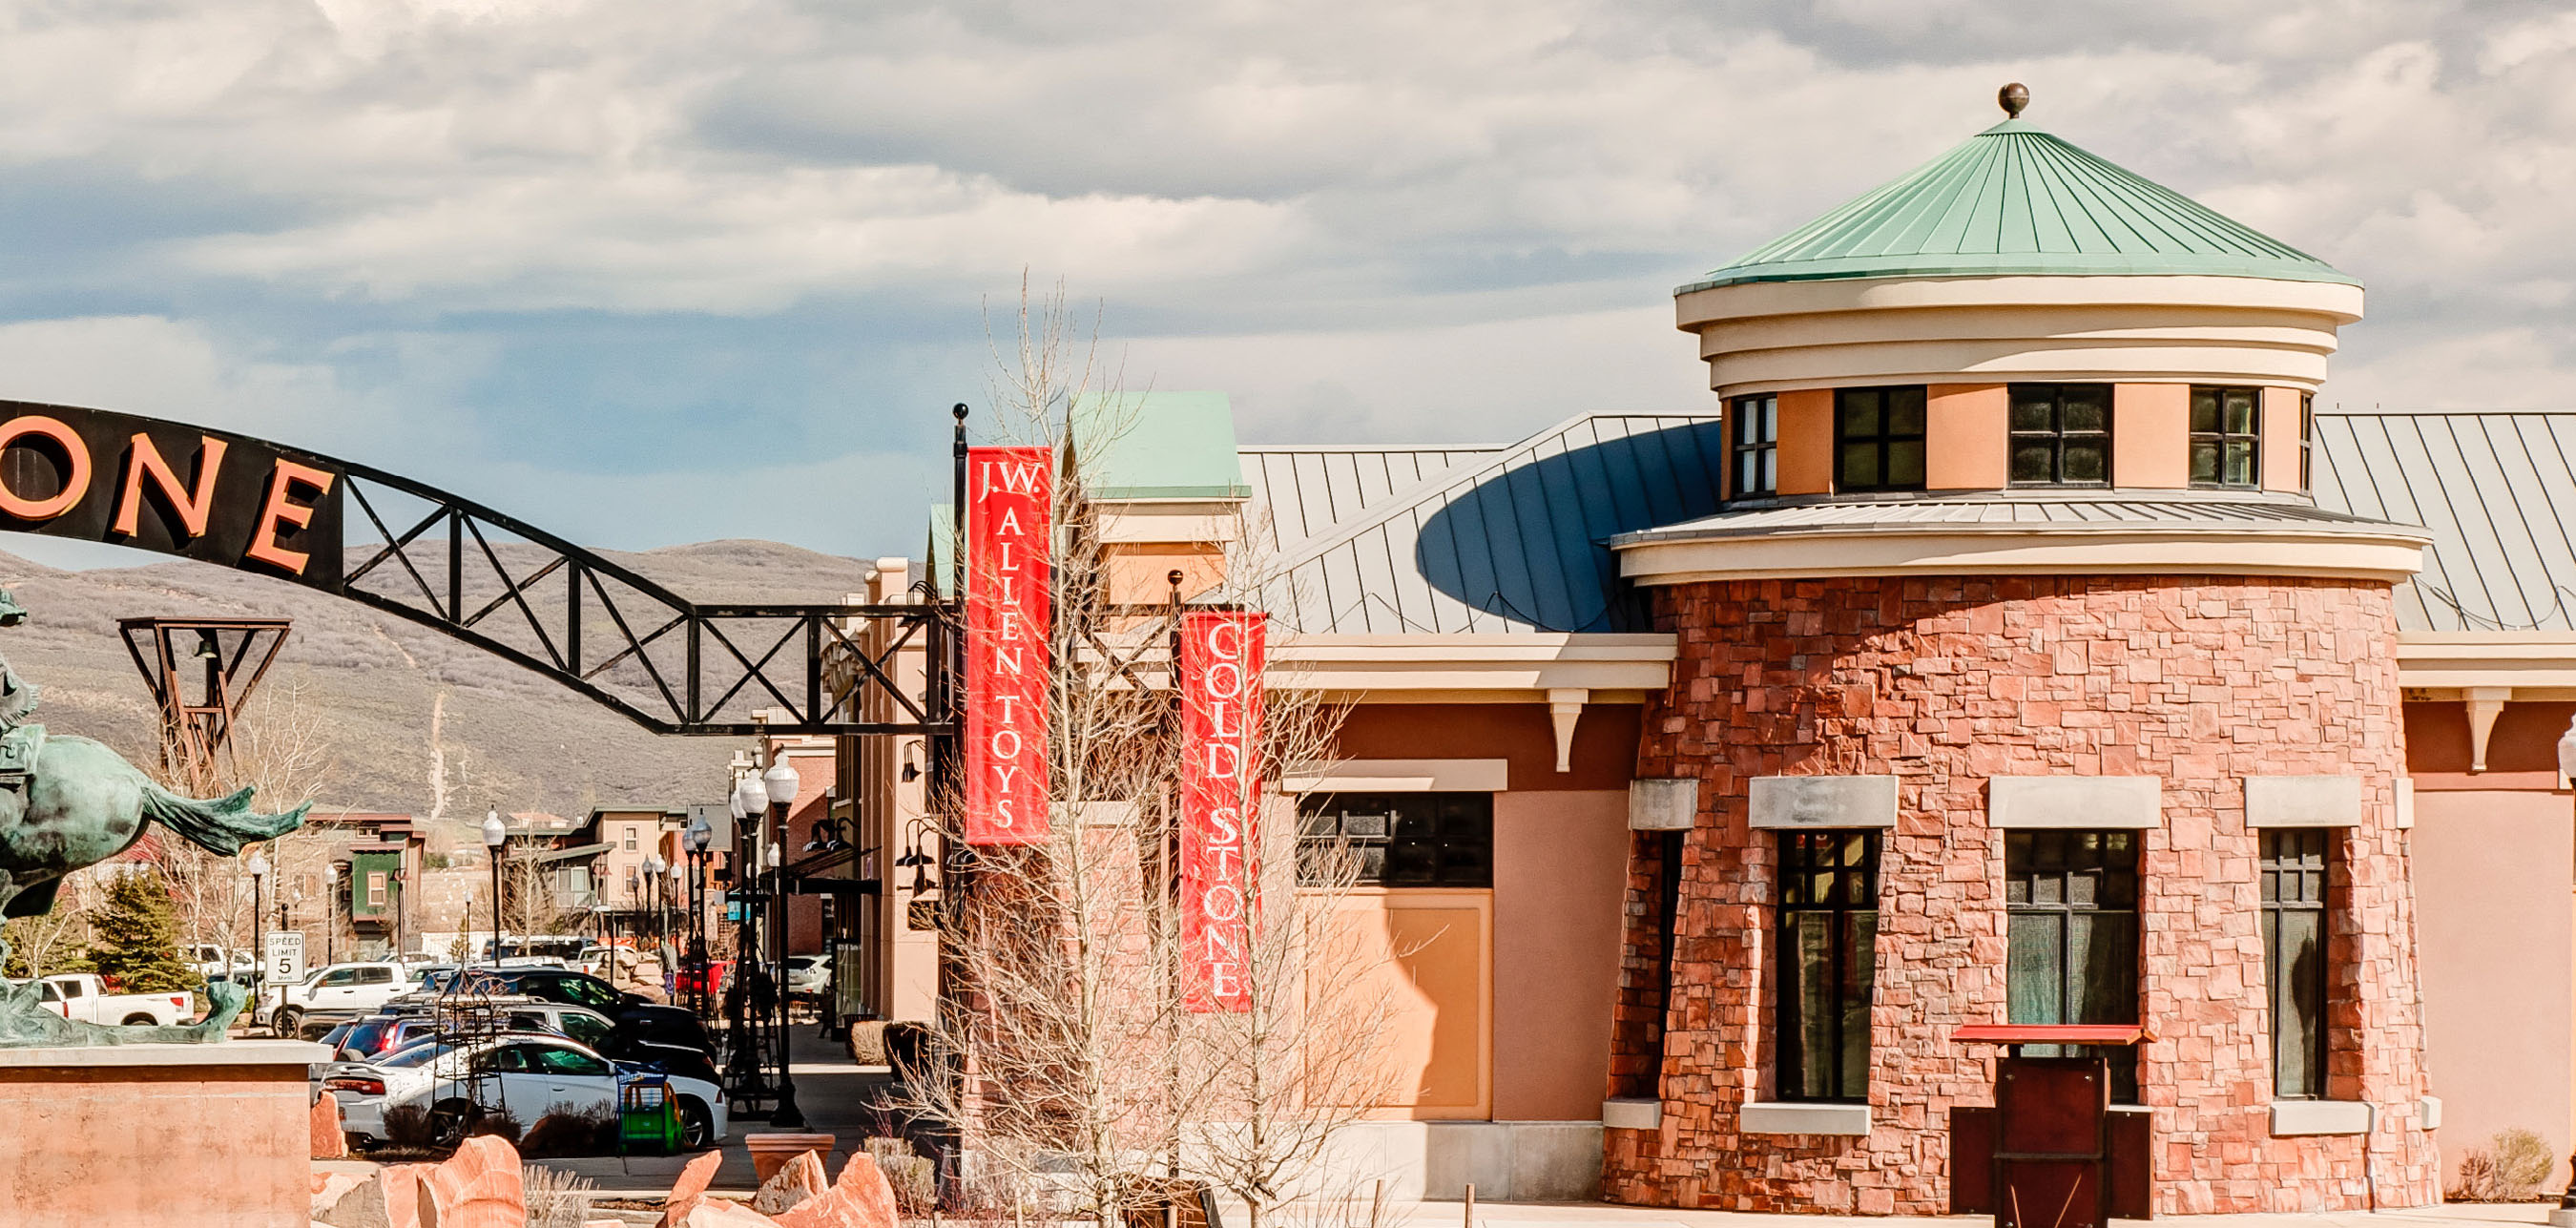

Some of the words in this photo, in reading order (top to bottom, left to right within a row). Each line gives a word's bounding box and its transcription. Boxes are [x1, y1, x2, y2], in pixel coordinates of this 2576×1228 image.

[977, 462, 1041, 504] J.W.
[994, 507, 1026, 675] ALLEN
[1205, 623, 1241, 779] COLD
[991, 695, 1022, 828] TOYS
[269, 937, 301, 946] SPEED
[1203, 807, 1243, 997] STONE
[272, 948, 297, 957] LIMIT
[279, 958, 291, 974] 5
